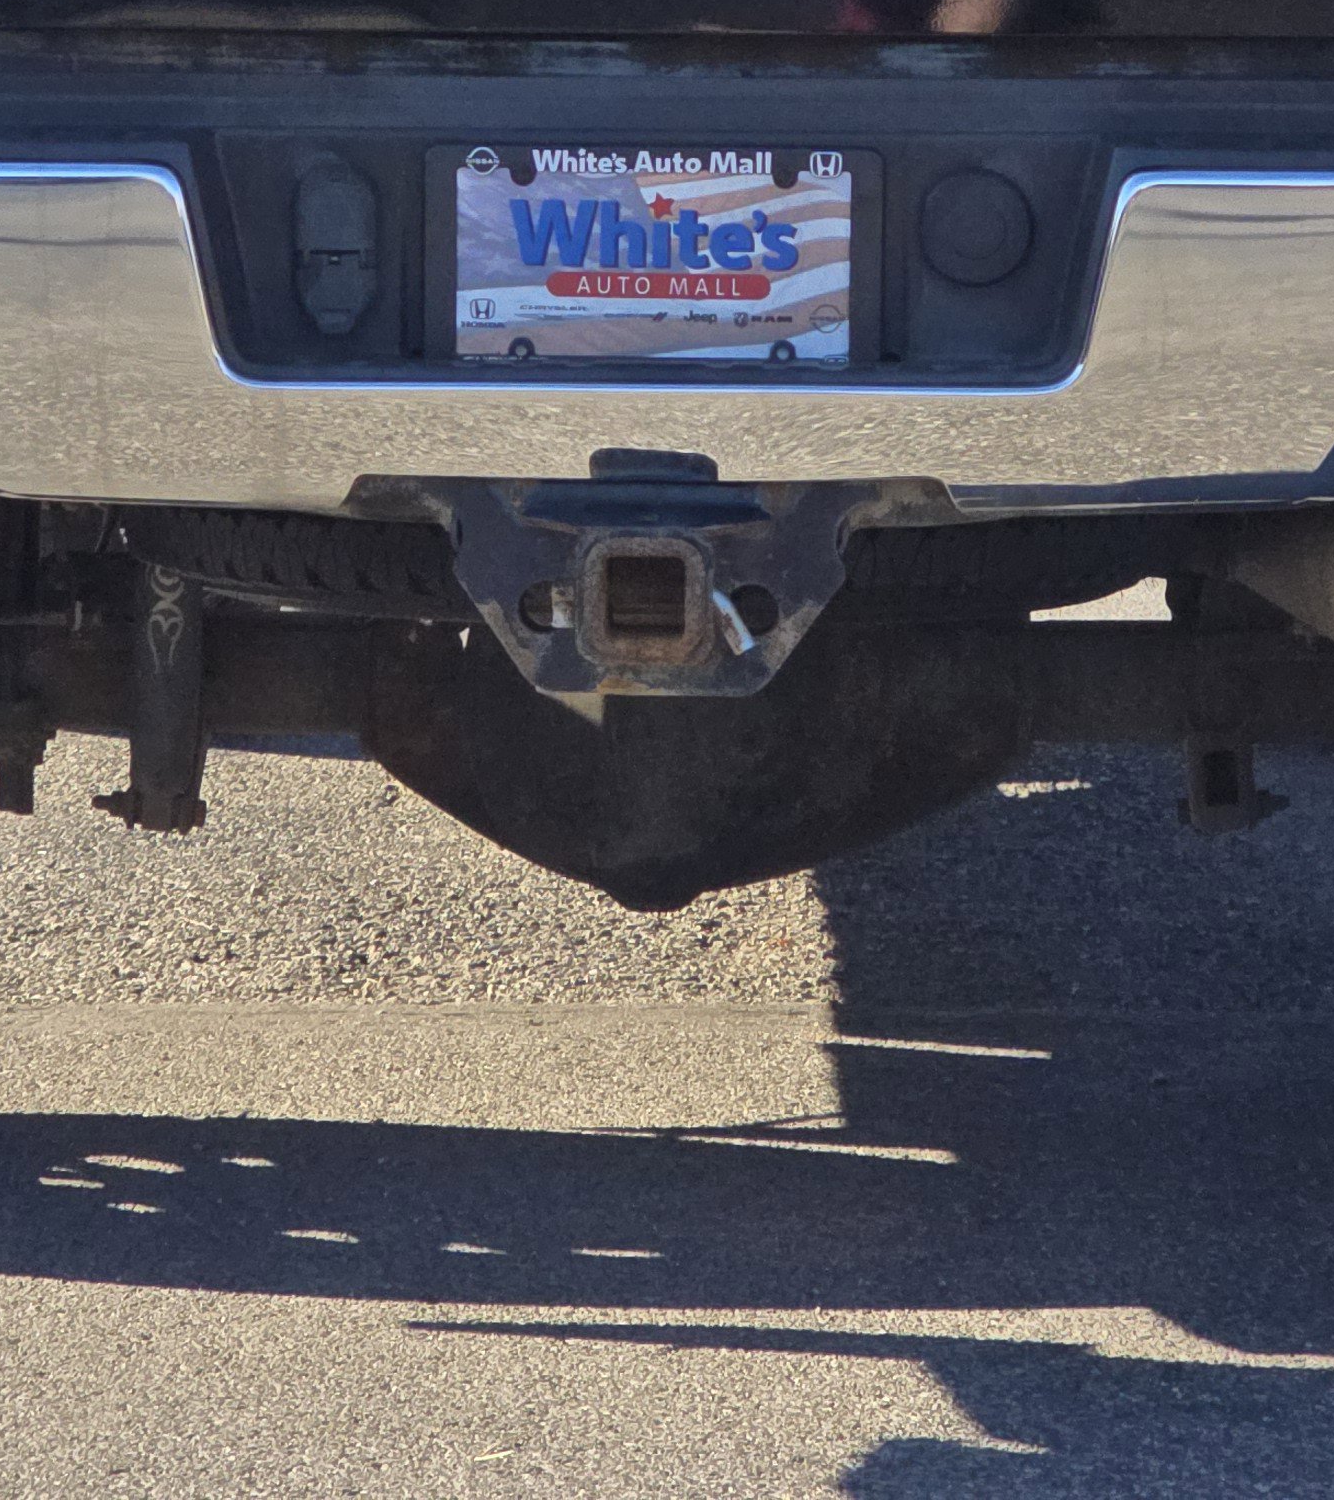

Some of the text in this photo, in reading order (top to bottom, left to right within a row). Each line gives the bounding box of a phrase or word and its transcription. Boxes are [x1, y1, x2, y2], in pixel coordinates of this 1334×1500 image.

[533, 149, 772, 174] White's Auto Mall
[509, 195, 799, 271] White's
[576, 275, 741, 296] AUTO MALL
[683, 310, 718, 324] Jeep
